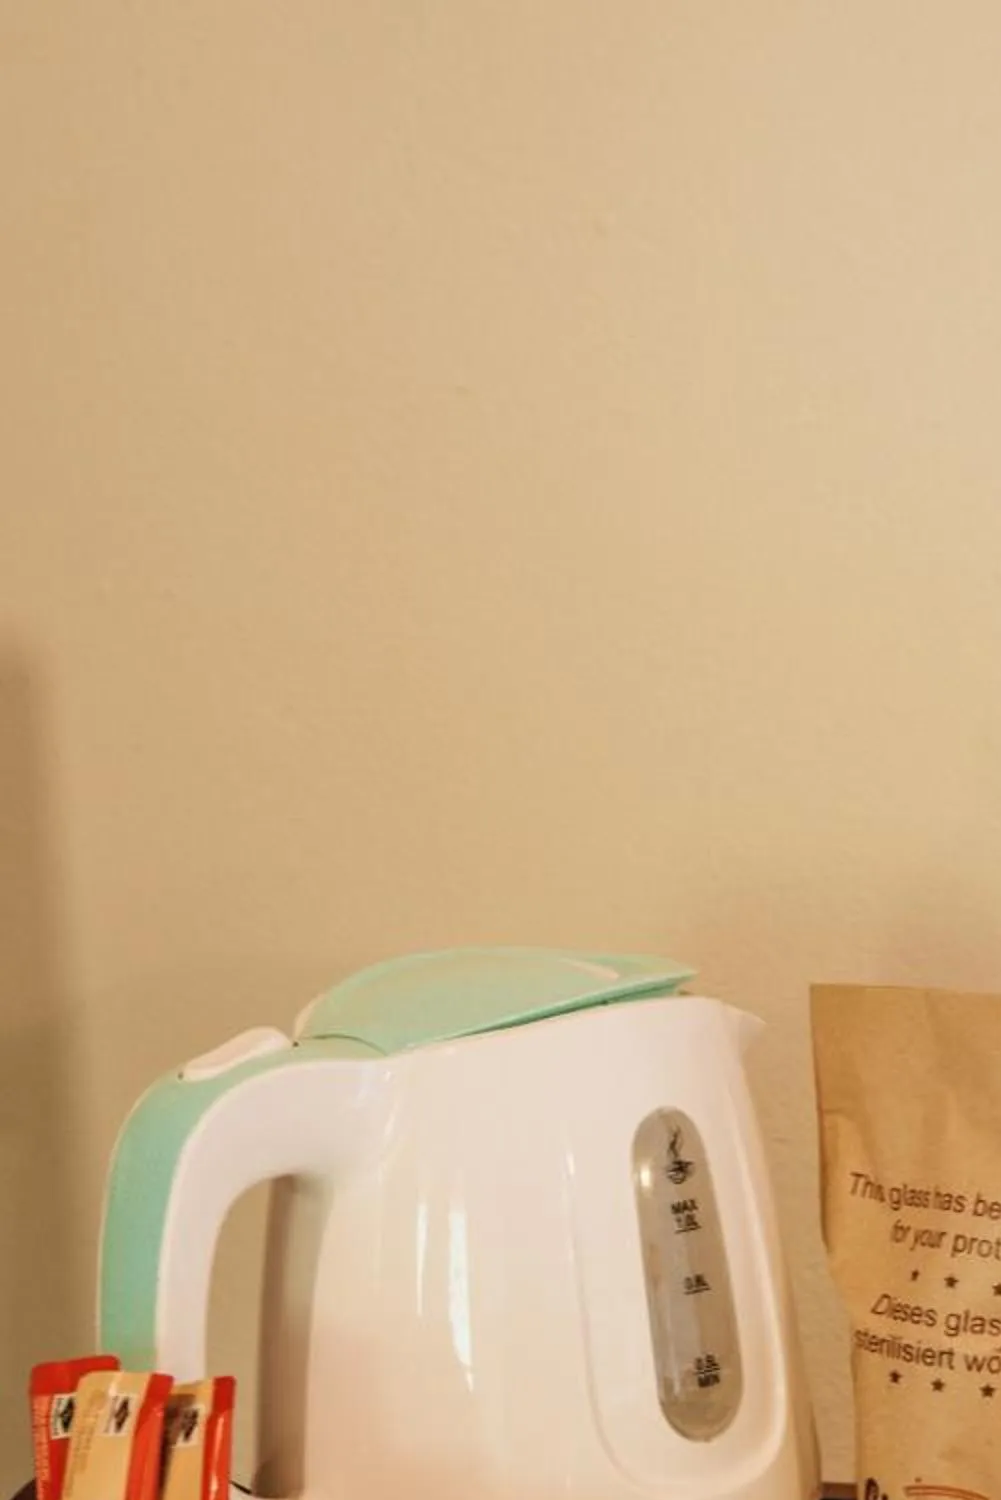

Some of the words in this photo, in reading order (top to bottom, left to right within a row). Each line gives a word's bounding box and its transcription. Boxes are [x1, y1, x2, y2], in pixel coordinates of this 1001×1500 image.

[889, 1183, 930, 1211] glass
[911, 1229, 947, 1251] your
[871, 1293, 938, 1327] Dieses
